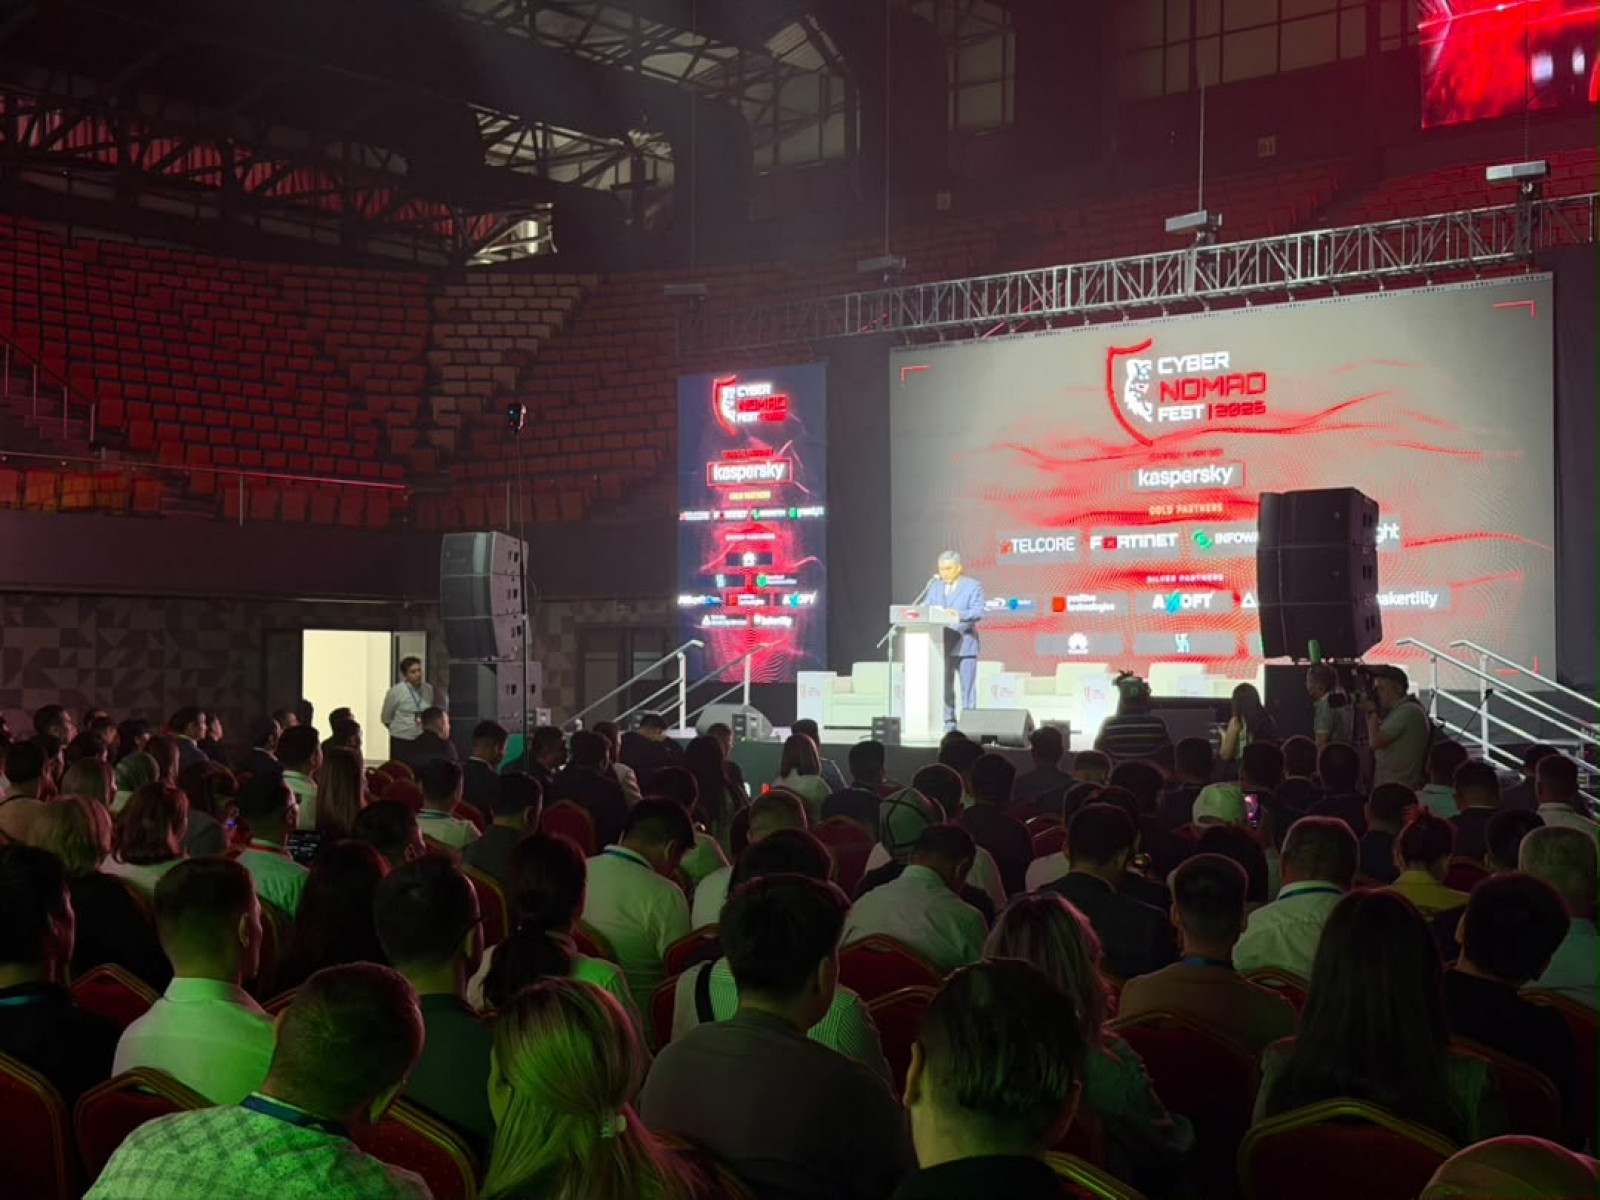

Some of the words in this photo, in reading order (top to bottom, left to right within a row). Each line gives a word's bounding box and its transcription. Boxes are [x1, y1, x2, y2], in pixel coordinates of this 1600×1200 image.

[1158, 351, 1230, 374] CYBER
[1160, 372, 1267, 402] NOMAD
[1158, 404, 1205, 422] FEST
[714, 461, 785, 484] kaspersky
[1138, 464, 1233, 488] kaspersky
[1011, 536, 1075, 553] TELCORE
[1090, 533, 1178, 550] FORTINET
